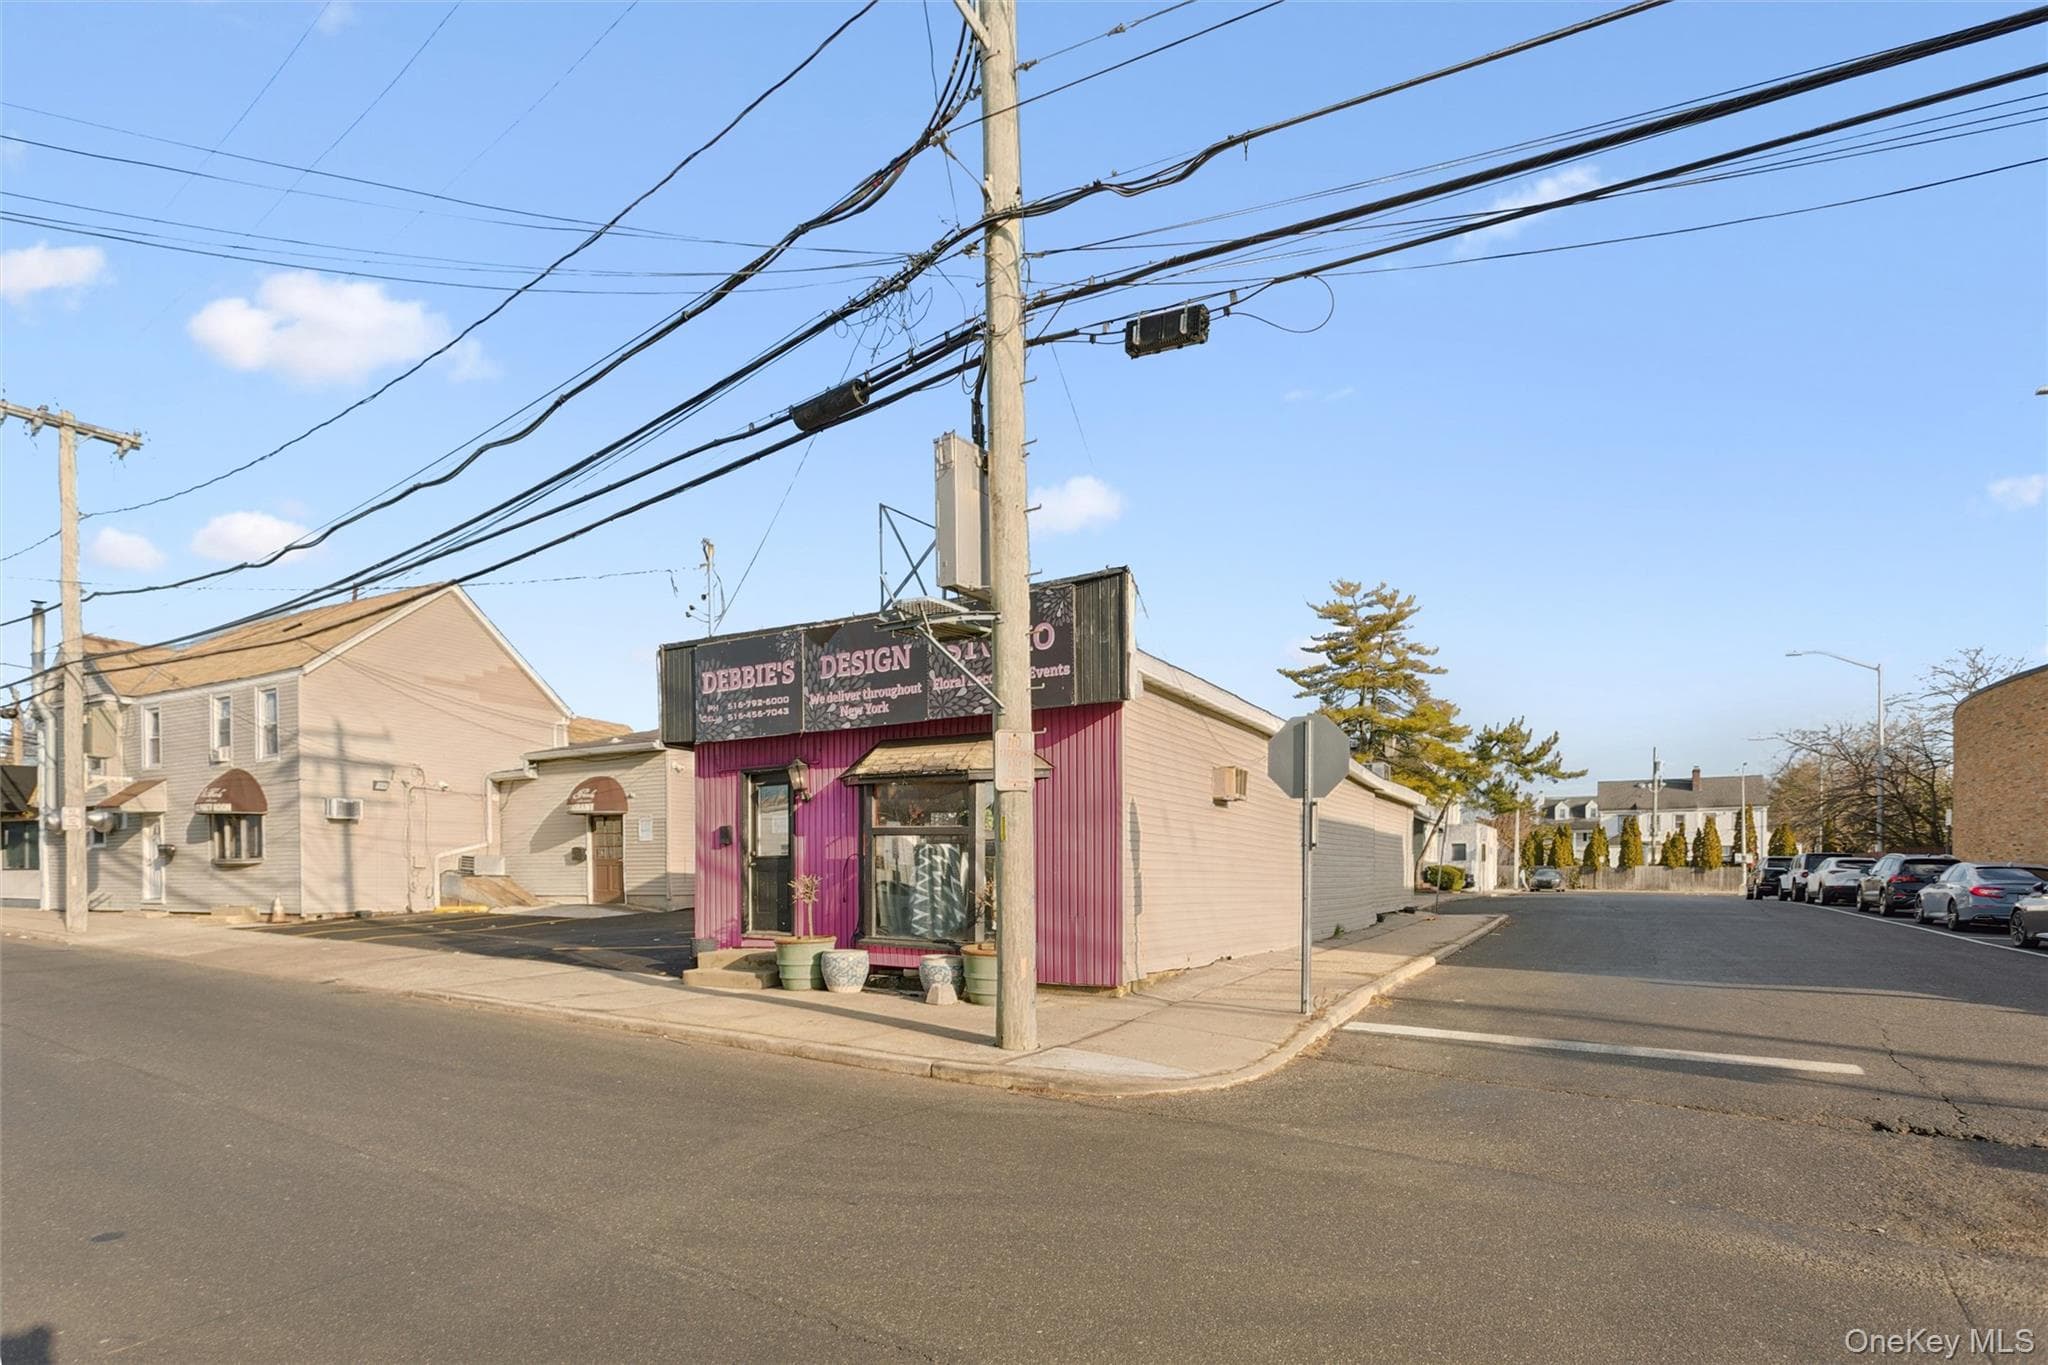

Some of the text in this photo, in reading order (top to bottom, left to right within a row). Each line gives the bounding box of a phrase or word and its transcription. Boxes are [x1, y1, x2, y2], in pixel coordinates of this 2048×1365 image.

[701, 660, 795, 694] DEBBIE'S
[819, 643, 912, 680] DESIGN
[932, 674, 965, 691] Floral
[809, 682, 922, 705] We deliver throughout
[840, 701, 890, 717] New York
